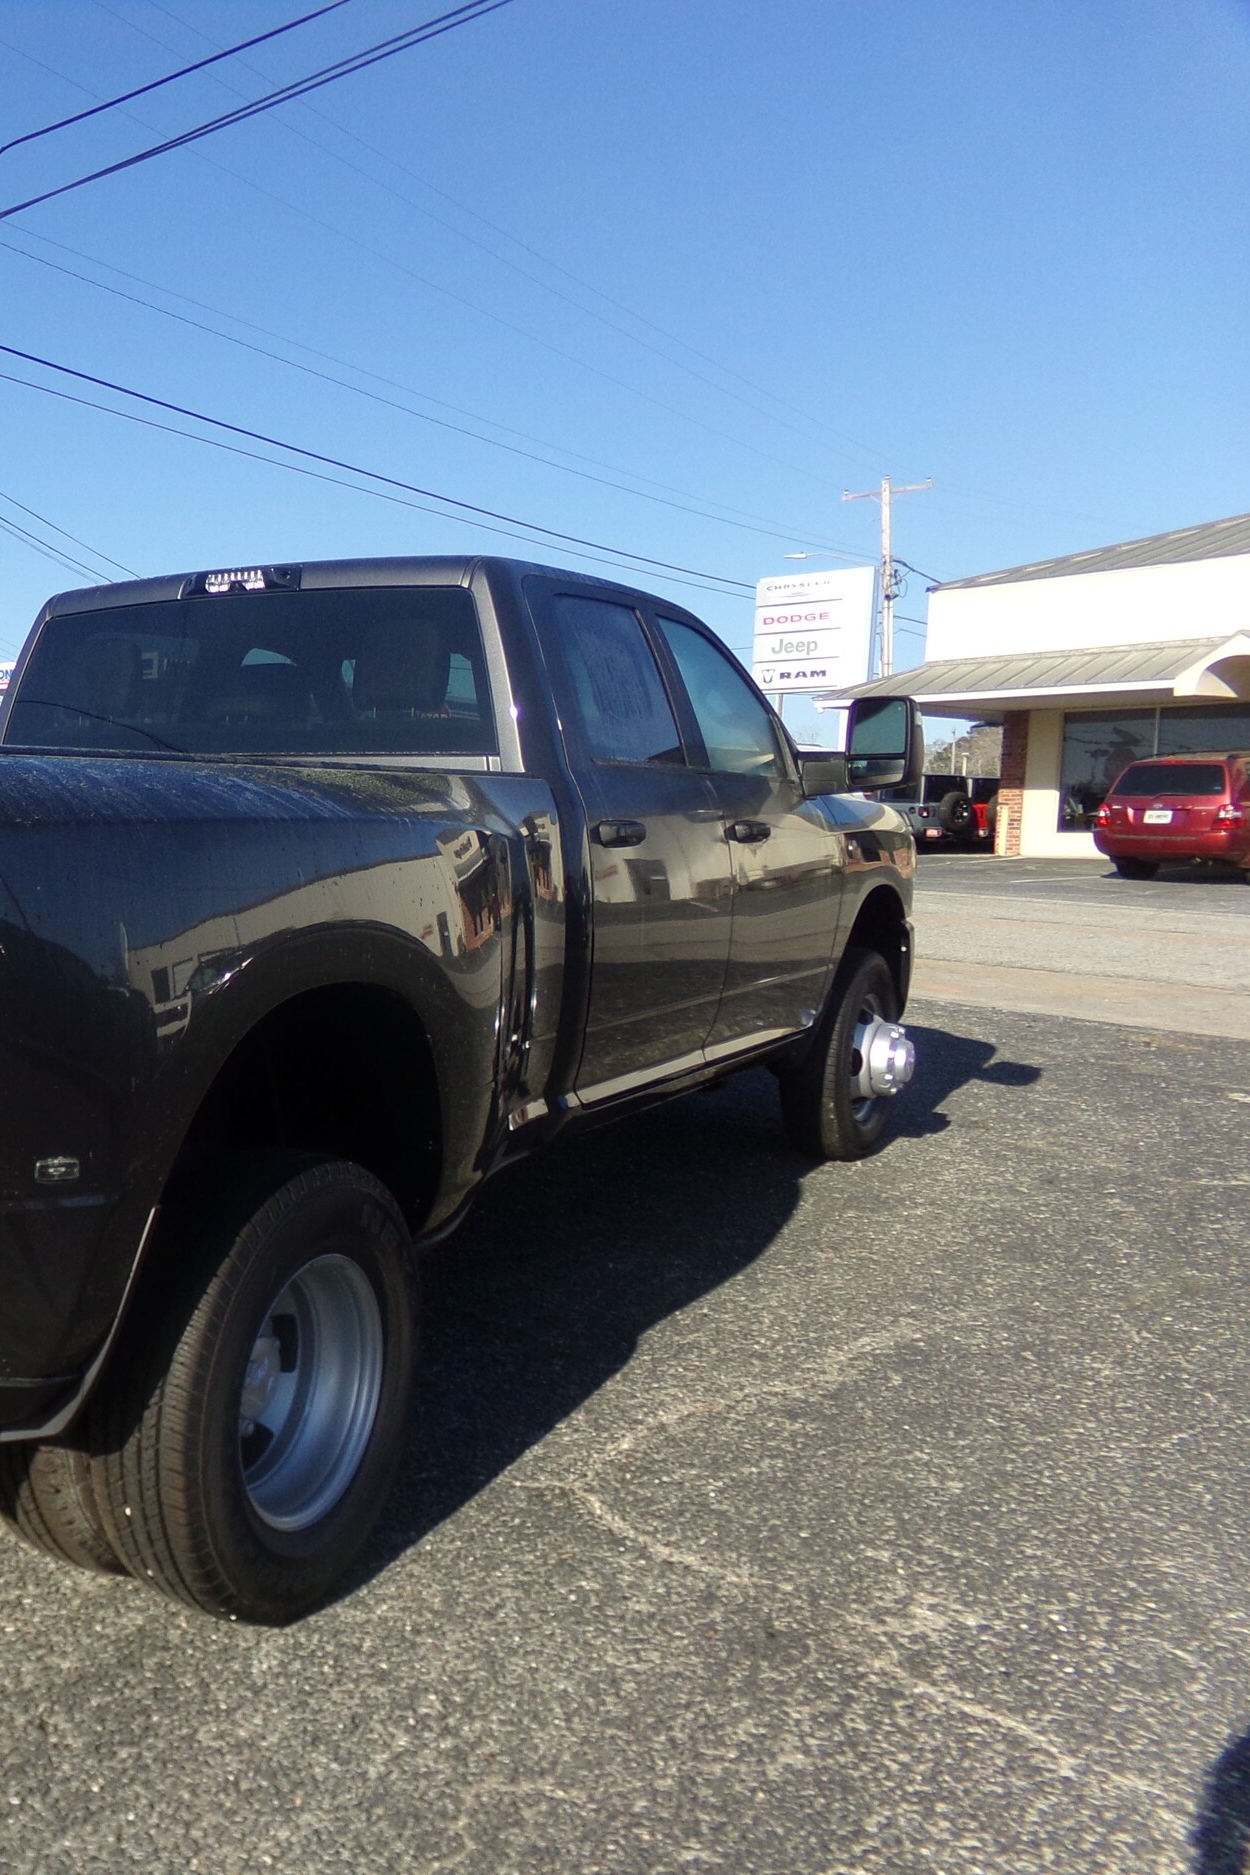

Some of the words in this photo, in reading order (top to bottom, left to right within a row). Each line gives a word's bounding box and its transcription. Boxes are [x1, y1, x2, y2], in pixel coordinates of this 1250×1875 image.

[763, 612, 830, 625] DODGE
[771, 638, 818, 655] Jeep
[779, 670, 827, 680] RAM
